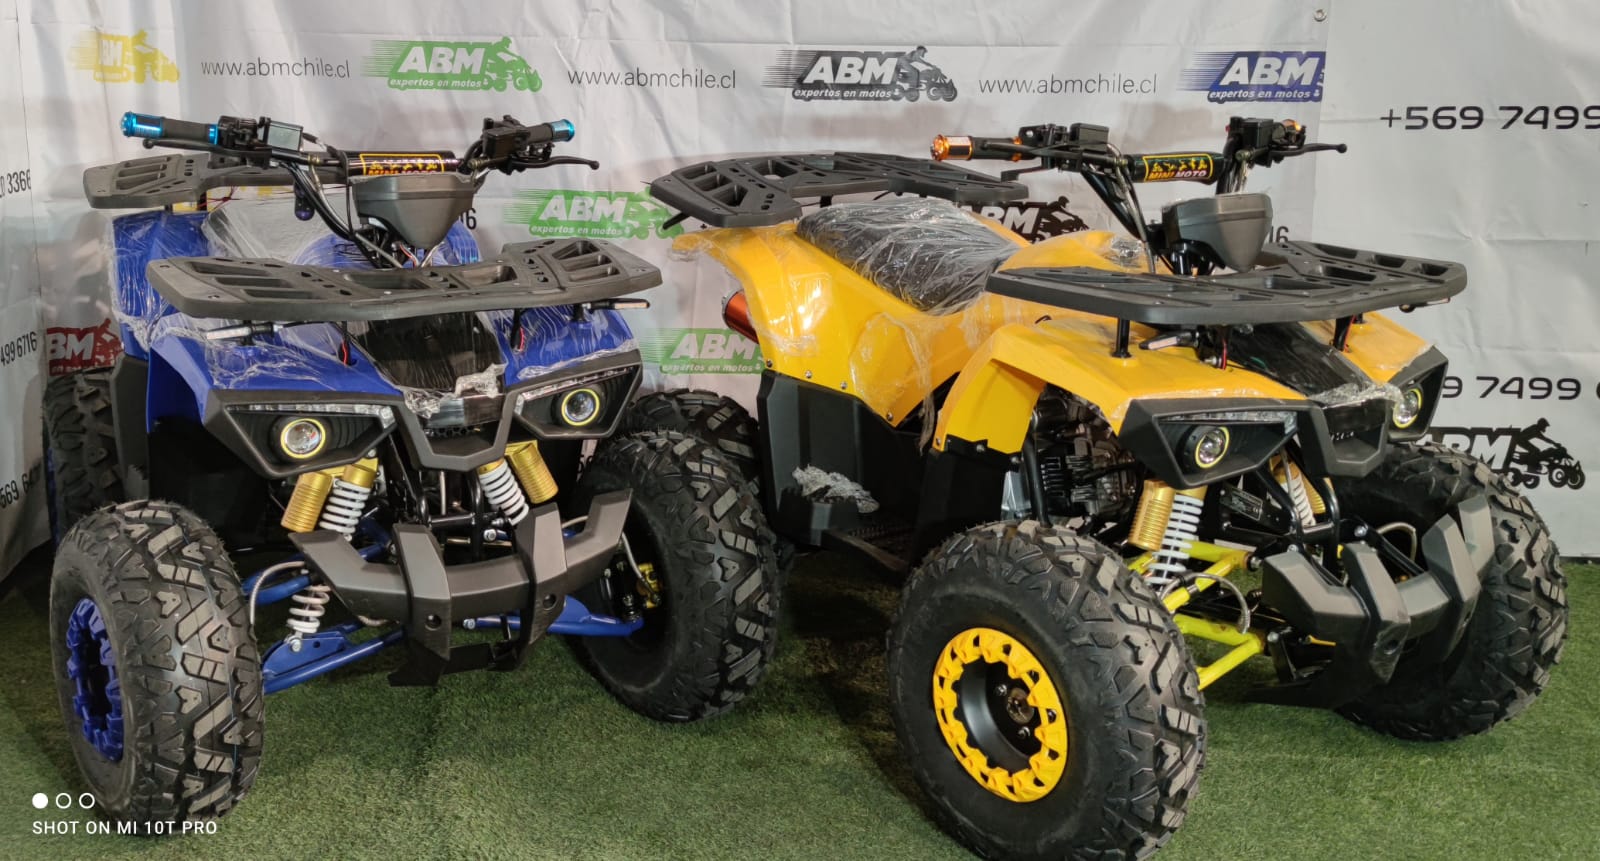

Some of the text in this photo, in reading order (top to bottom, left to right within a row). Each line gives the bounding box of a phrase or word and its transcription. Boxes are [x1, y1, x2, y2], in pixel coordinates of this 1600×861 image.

[201, 56, 351, 79] www.abmchile.cl
[398, 47, 485, 74] ABM
[803, 56, 898, 84] ABM
[1219, 57, 1320, 86] ABM
[389, 79, 433, 89] expertos
[451, 80, 482, 88] motos
[567, 68, 736, 90] www.abmchile.cl
[978, 73, 1157, 95] www.abmchile.cl
[794, 88, 892, 99] expertos en motos
[1209, 90, 1255, 101] expertos
[1274, 90, 1310, 99] motos
[1380, 106, 1600, 131] +569 7499
[1148, 170, 1207, 180] MINI MOTO
[539, 195, 629, 223] ABM
[530, 226, 575, 236] expertos
[577, 227, 589, 235] en
[16, 331, 37, 358] 6716
[671, 333, 756, 360] ABM
[1476, 376, 1582, 400] 7499
